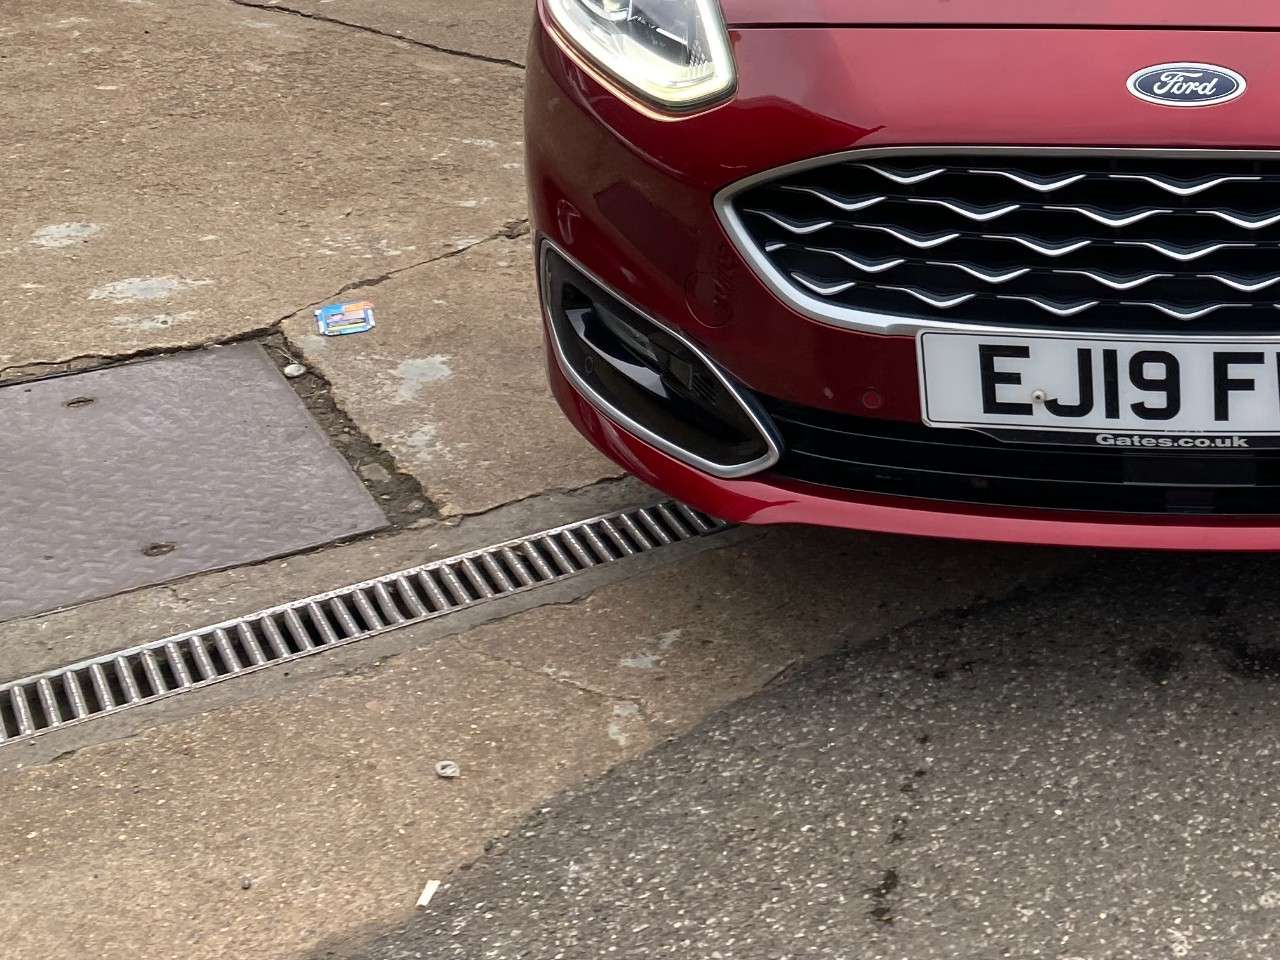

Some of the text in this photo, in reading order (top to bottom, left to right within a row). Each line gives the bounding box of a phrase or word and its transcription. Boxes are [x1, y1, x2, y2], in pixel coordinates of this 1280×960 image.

[1153, 71, 1219, 95] Ford
[978, 344, 1182, 421] EJ19
[1095, 433, 1249, 448] Gates.co.uk
